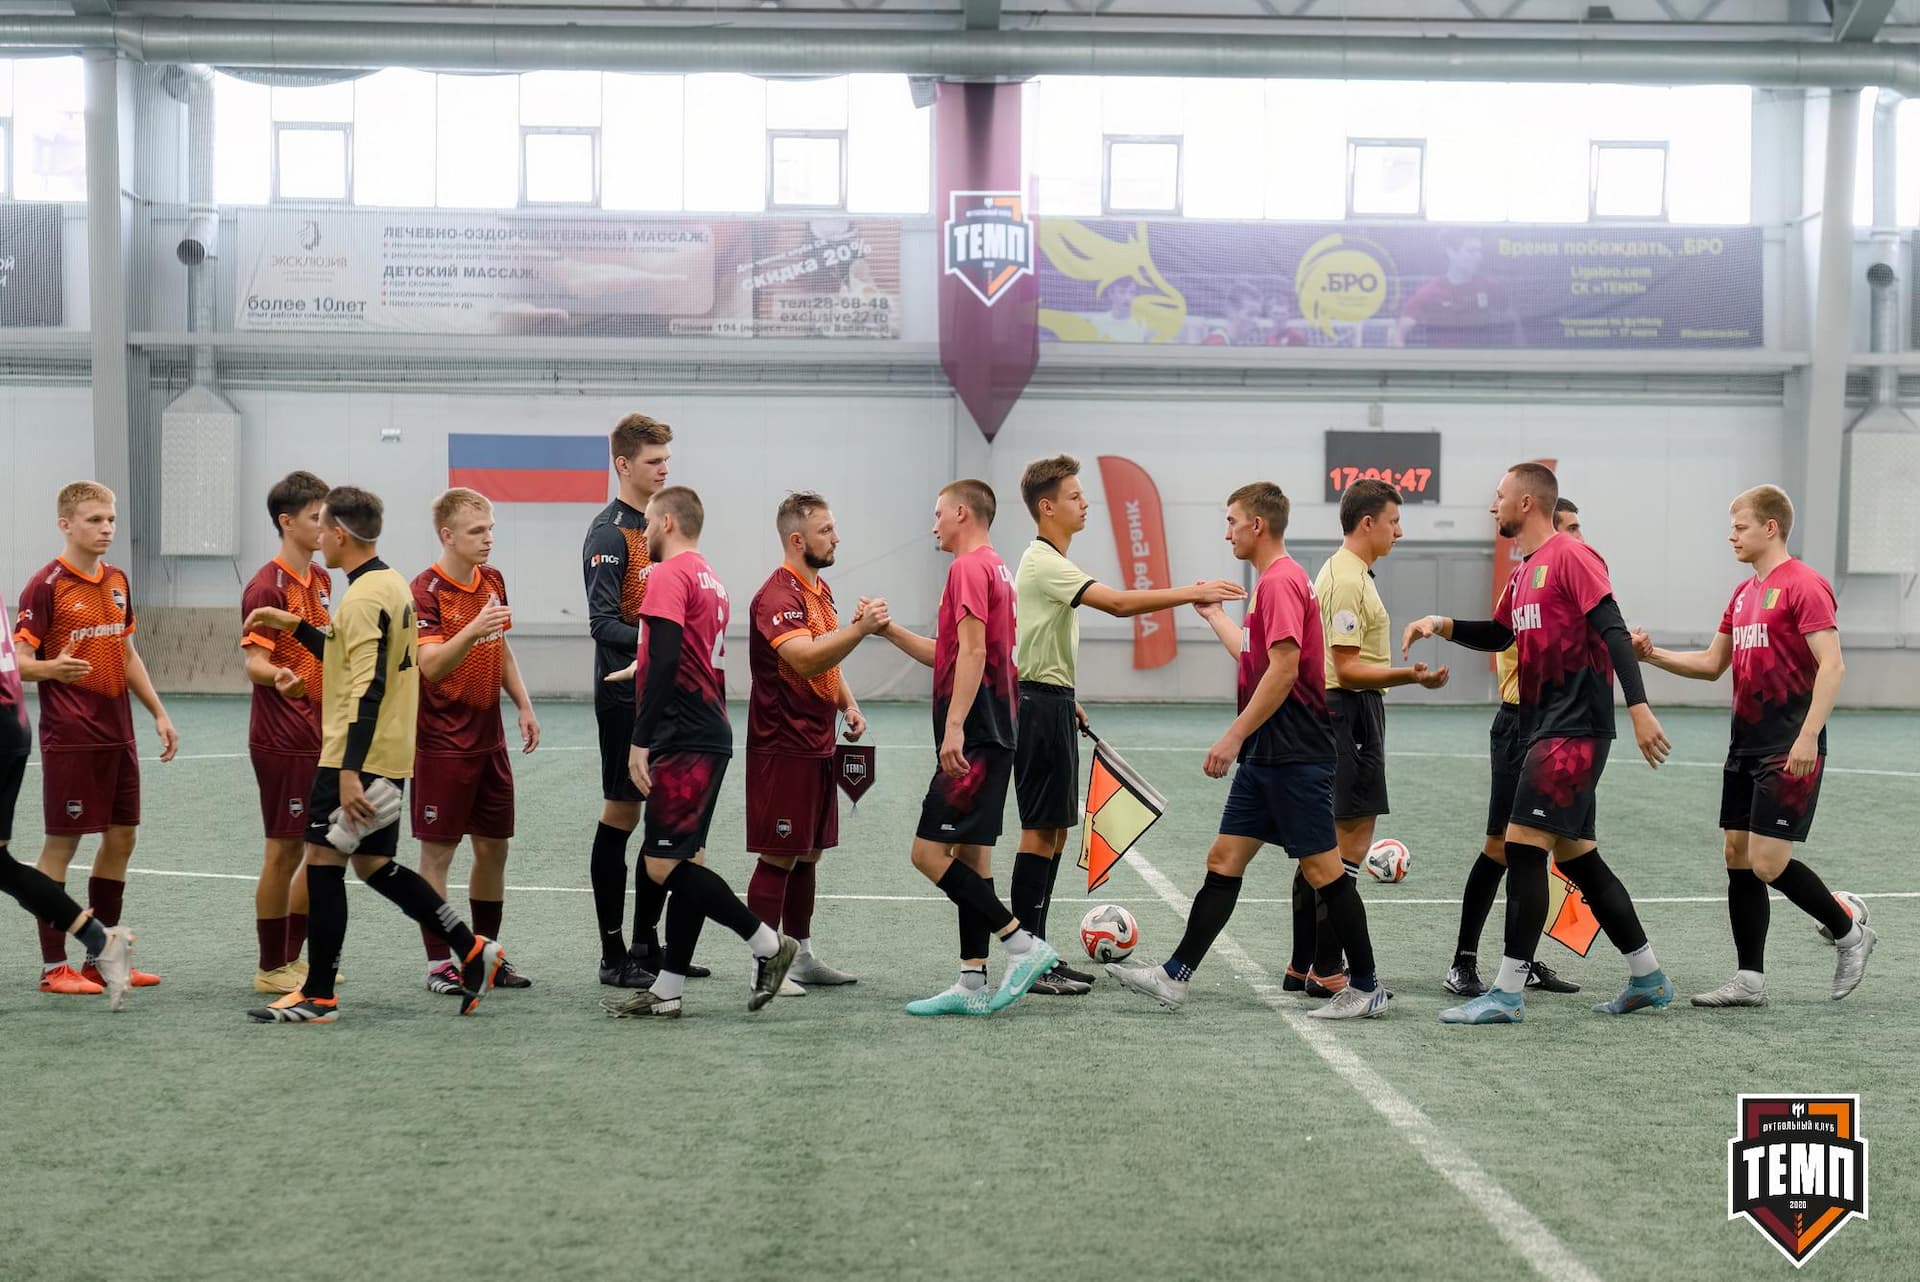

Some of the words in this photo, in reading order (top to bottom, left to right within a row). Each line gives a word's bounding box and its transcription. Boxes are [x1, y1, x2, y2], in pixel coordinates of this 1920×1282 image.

[633, 231, 709, 243] МАССАЖ:
[953, 223, 1025, 263] ТЕМП
[1499, 239, 1558, 258] Время
[1564, 240, 1673, 258] побеждать,
[1680, 238, 1723, 255] .БРО
[383, 264, 458, 279] ДЕТСКИЙ
[463, 267, 540, 280] МАССАЖ:
[741, 259, 818, 289] скидка
[823, 238, 872, 267] 20%
[1319, 272, 1379, 293] .БРО
[248, 296, 306, 312] более
